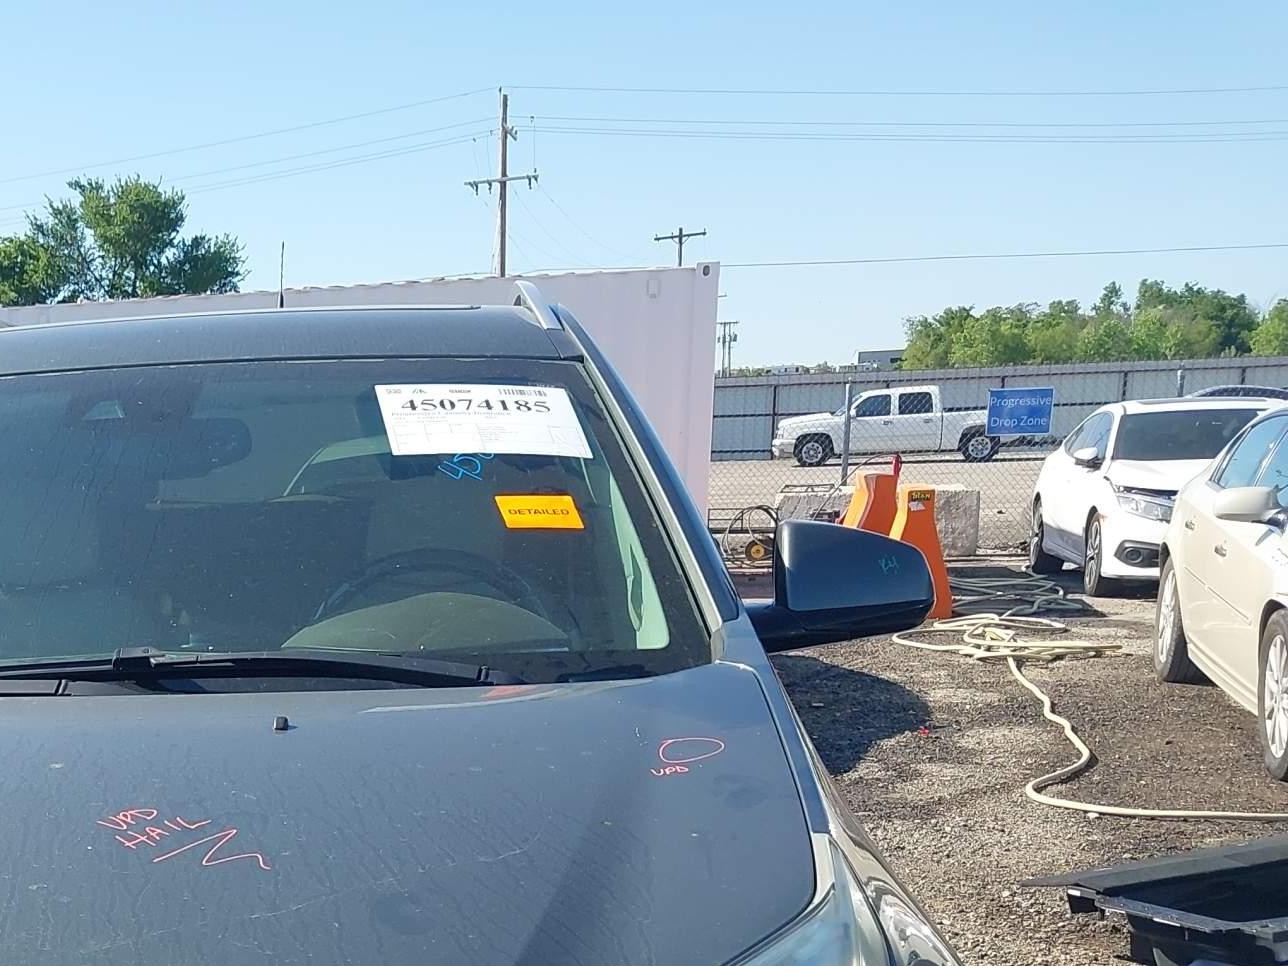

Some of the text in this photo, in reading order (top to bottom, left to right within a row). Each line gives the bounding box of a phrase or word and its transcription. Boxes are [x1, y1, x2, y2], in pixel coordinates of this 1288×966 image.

[401, 398, 551, 413] 45074185
[990, 396, 1052, 408] Progressive
[991, 415, 1047, 428] Drop Zone
[507, 508, 571, 516] DETAILED
[115, 816, 212, 849] HAIL
